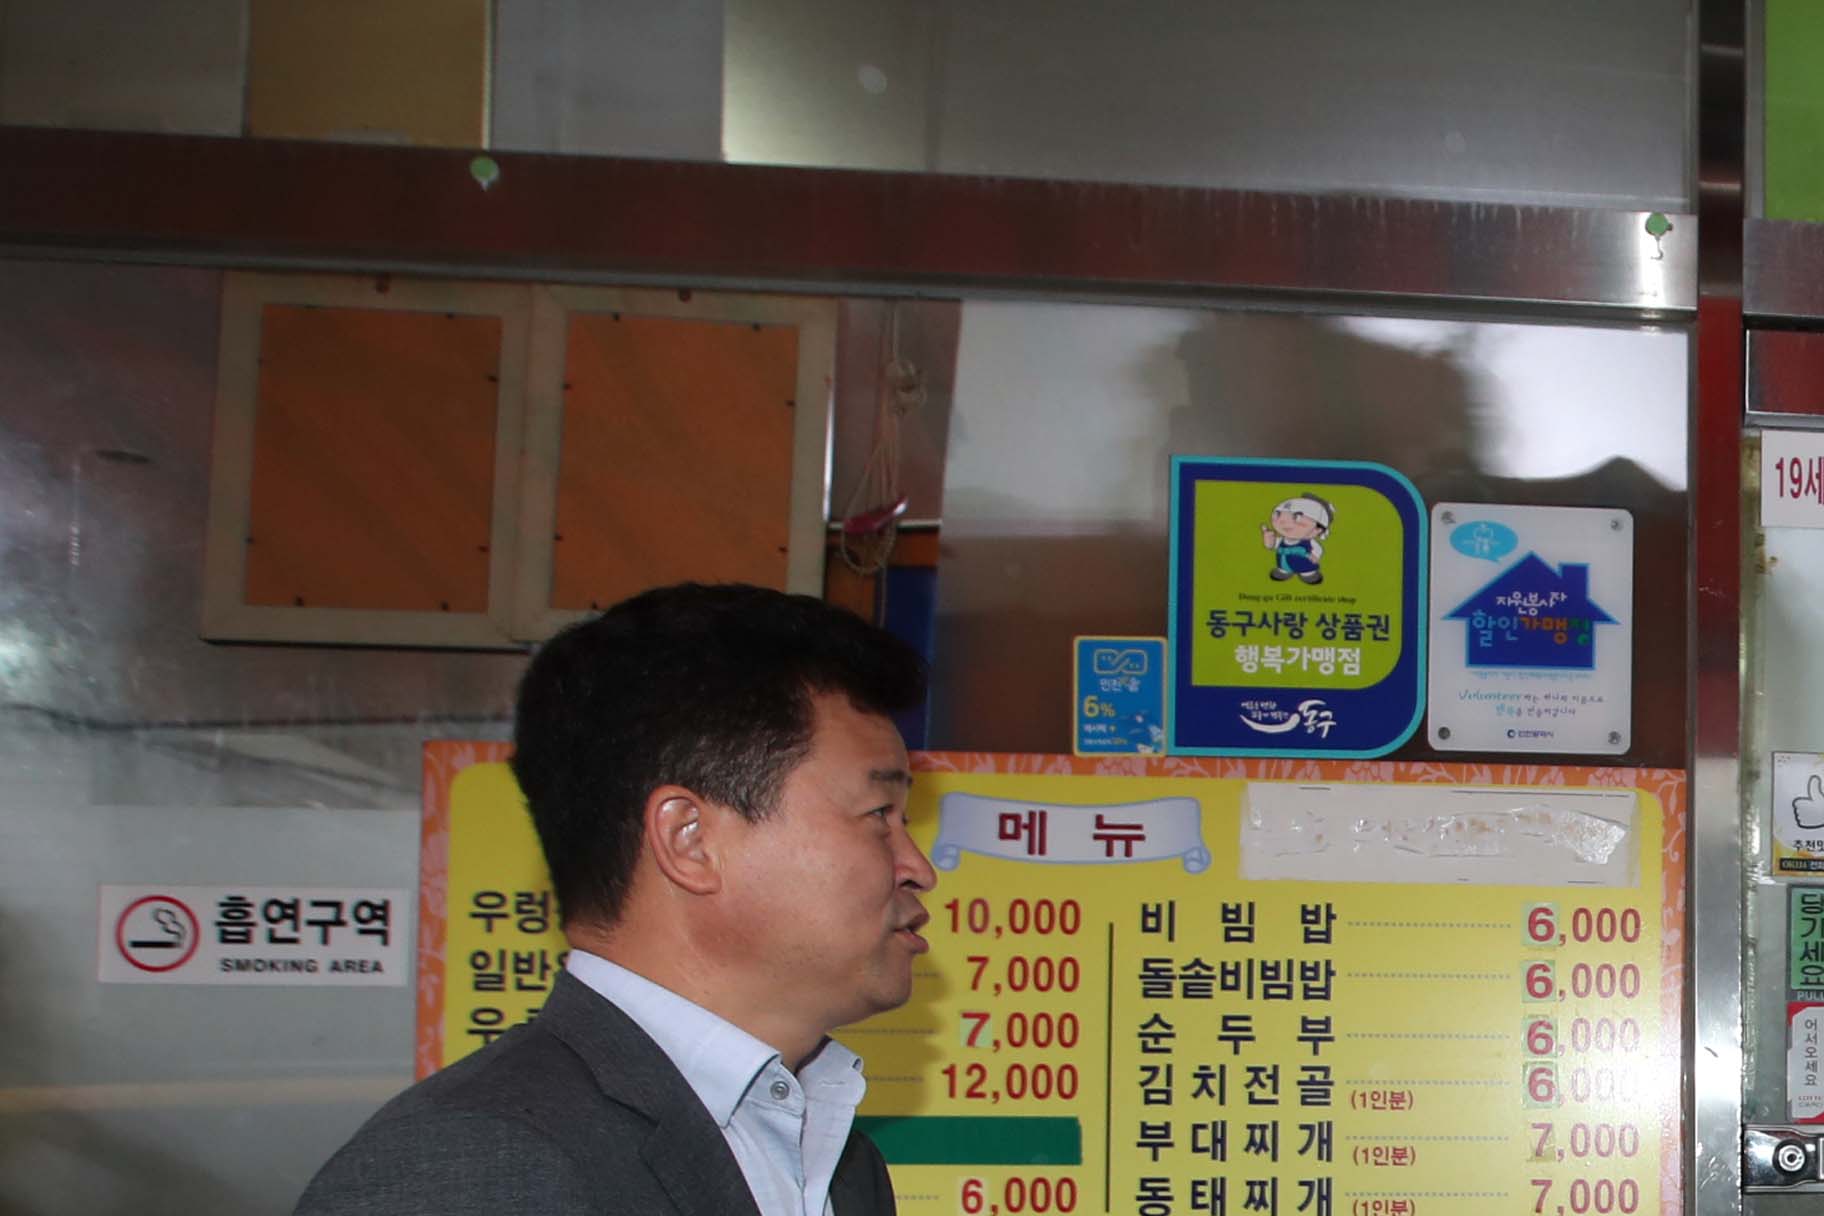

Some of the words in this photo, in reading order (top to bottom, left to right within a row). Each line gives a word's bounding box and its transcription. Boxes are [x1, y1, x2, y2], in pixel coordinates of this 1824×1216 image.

[1206, 610, 1308, 640] 동구사랑
[1315, 613, 1390, 641] 상품권
[1235, 645, 1360, 675] 행복가맹점
[1084, 696, 1115, 717] 6%
[215, 896, 390, 945] 흡연구역
[944, 898, 1081, 939] 10,000
[1527, 907, 1640, 948] 6,000
[219, 958, 318, 974] SMOKING
[329, 958, 383, 974] AREA
[966, 955, 1081, 996] 7,000
[1138, 956, 1336, 1001] 돌솥비빔밥
[1526, 963, 1640, 1002] 6,000
[963, 1012, 1079, 1051] 7,000
[1526, 1018, 1640, 1058] 6,000
[1805, 1019, 1818, 1086] 어서오세요
[942, 1063, 1078, 1103] 12,000
[1138, 1063, 1335, 1106] 김치전골
[1351, 1089, 1413, 1110] (1인분)
[1527, 1062, 1640, 1101] 6,000
[1136, 1120, 1334, 1162] 부대찌개
[1353, 1144, 1416, 1167] (1인분)
[1531, 1122, 1639, 1162] 7,000
[961, 1178, 1077, 1216] 6,000
[1531, 1178, 1639, 1216] 7,000
